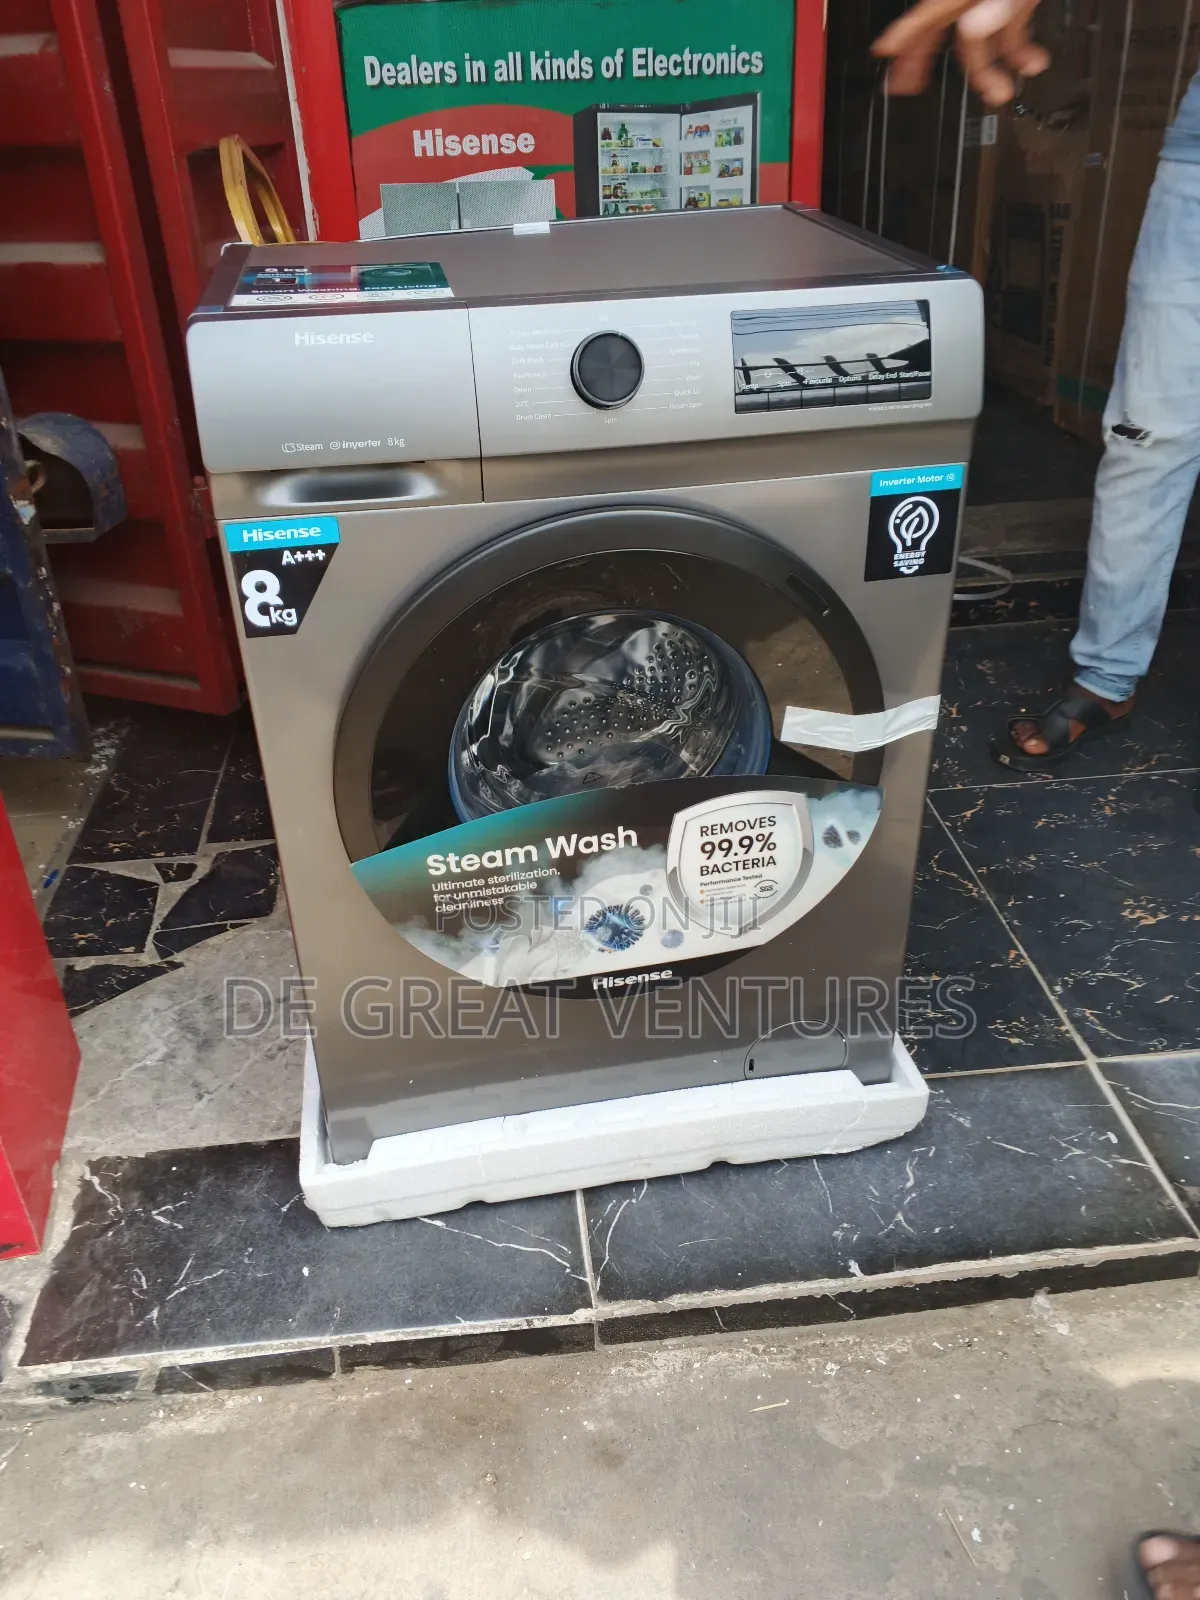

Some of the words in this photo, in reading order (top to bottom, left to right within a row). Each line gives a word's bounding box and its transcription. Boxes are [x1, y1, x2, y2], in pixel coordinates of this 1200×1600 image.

[363, 54, 458, 87] Dealers
[464, 52, 487, 83] in
[494, 50, 523, 81] all
[530, 49, 594, 81] kinds
[601, 47, 624, 78] of
[632, 44, 764, 77] Electronics
[412, 128, 536, 157] Hisense
[294, 331, 375, 347] Hisense
[685, 374, 701, 382] Wool
[838, 373, 862, 384] Options
[513, 386, 532, 394] Down
[674, 388, 692, 397] Quick
[692, 388, 700, 396] 15
[516, 413, 534, 421] Drum
[534, 411, 552, 420] Clean
[603, 416, 618, 425] Spin
[296, 440, 324, 453] Steam
[342, 438, 382, 450] inverter
[879, 476, 916, 488] Inverter
[917, 473, 944, 485] Motor
[242, 525, 322, 543] Hisense
[281, 548, 326, 566] A+++
[893, 551, 927, 560] ENERGY
[893, 557, 925, 568] SAVING
[700, 815, 777, 837] REMOVES
[427, 844, 538, 877] Steam
[544, 825, 638, 859] Wash
[700, 831, 777, 861] 99.9%
[700, 855, 777, 877] BACTERIA
[431, 876, 486, 893] Ultimate
[487, 866, 561, 885] sterilization,
[700, 877, 741, 887] Performance
[741, 873, 763, 882] Tested
[433, 892, 452, 904] for
[453, 881, 538, 901] unmistakable
[759, 885, 774, 893] SGS
[435, 896, 505, 914] cleanliness
[591, 967, 674, 990] Hisense
